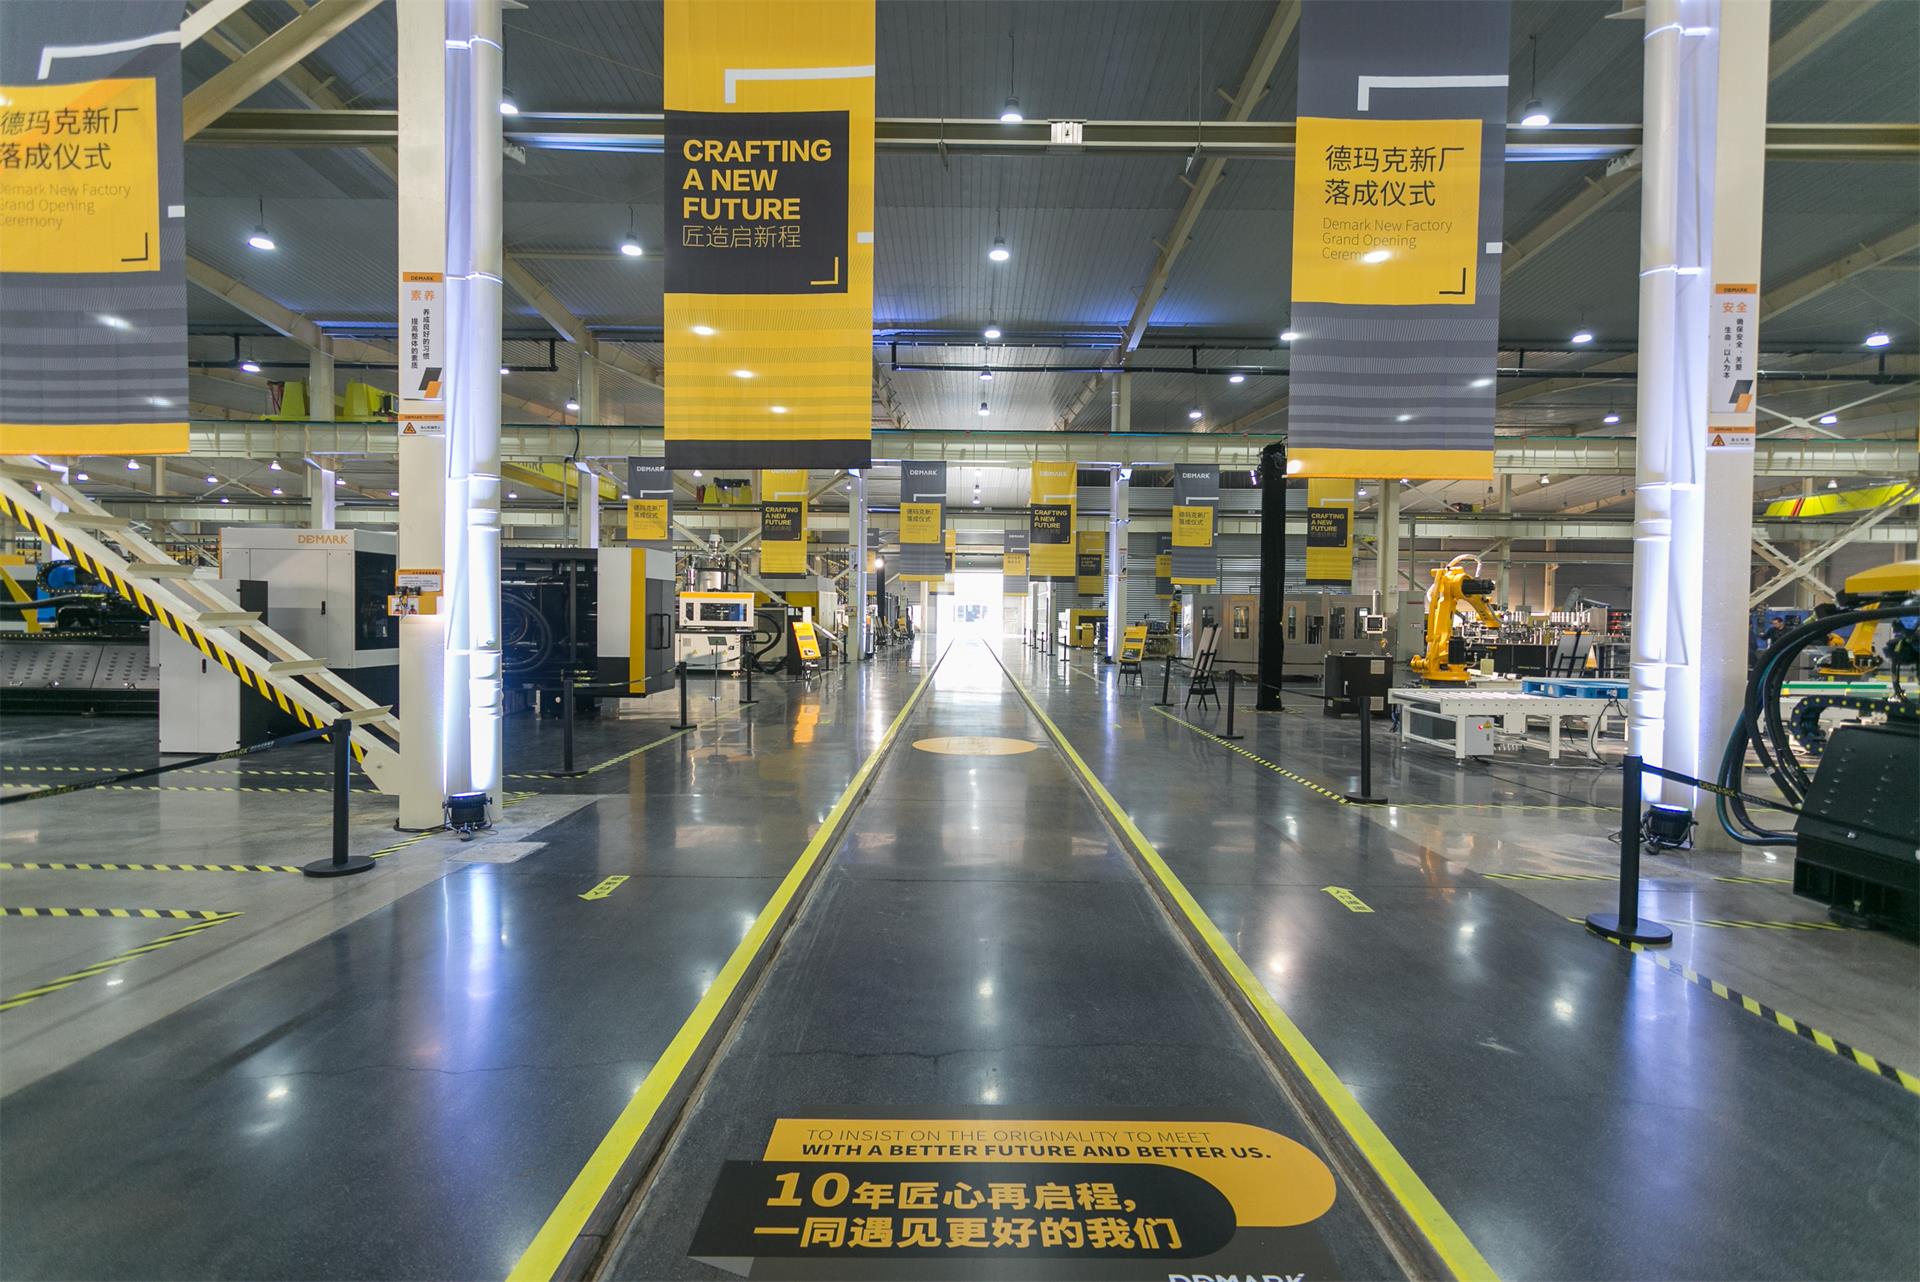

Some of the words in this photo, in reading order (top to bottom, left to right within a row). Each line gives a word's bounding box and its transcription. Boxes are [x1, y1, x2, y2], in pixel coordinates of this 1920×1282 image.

[1, 107, 139, 135] 德玛克新厂
[0, 142, 111, 170] 落成仪式
[683, 139, 832, 163] CRAFTING
[1325, 144, 1464, 173] 德玛克新厂
[49, 184, 79, 197] New
[82, 183, 131, 199] Factory
[682, 168, 704, 191] A
[711, 169, 778, 192] NEW
[1325, 178, 1436, 207] 落成仪式
[38, 200, 95, 215] Opening
[683, 197, 801, 220] FUTURE
[682, 225, 802, 248] 匠造启新程
[1323, 217, 1372, 231] Demark
[1374, 220, 1405, 232] New
[1405, 219, 1453, 234] Factory
[1322, 233, 1359, 246] Grand
[1363, 234, 1417, 250] Opening
[1722, 302, 1747, 313] 安全
[297, 534, 349, 545] DEMARK
[808, 1129, 833, 1141] TO
[839, 1129, 904, 1141] INSIST
[910, 1129, 940, 1141] ON
[946, 1130, 986, 1142] THE
[993, 1130, 1118, 1142] ORIGINALITY
[1123, 1131, 1152, 1143] TO
[1157, 1131, 1211, 1143] MEET
[802, 1144, 862, 1156] WITH
[867, 1145, 883, 1156] A
[889, 1145, 977, 1156] BETTER
[984, 1145, 1080, 1156] FUTURE
[1082, 1145, 1130, 1157] AND
[1136, 1146, 1227, 1158] BETTER
[1230, 1147, 1272, 1159] US.
[752, 1216, 1183, 1250] 一同遇见更好的我们
